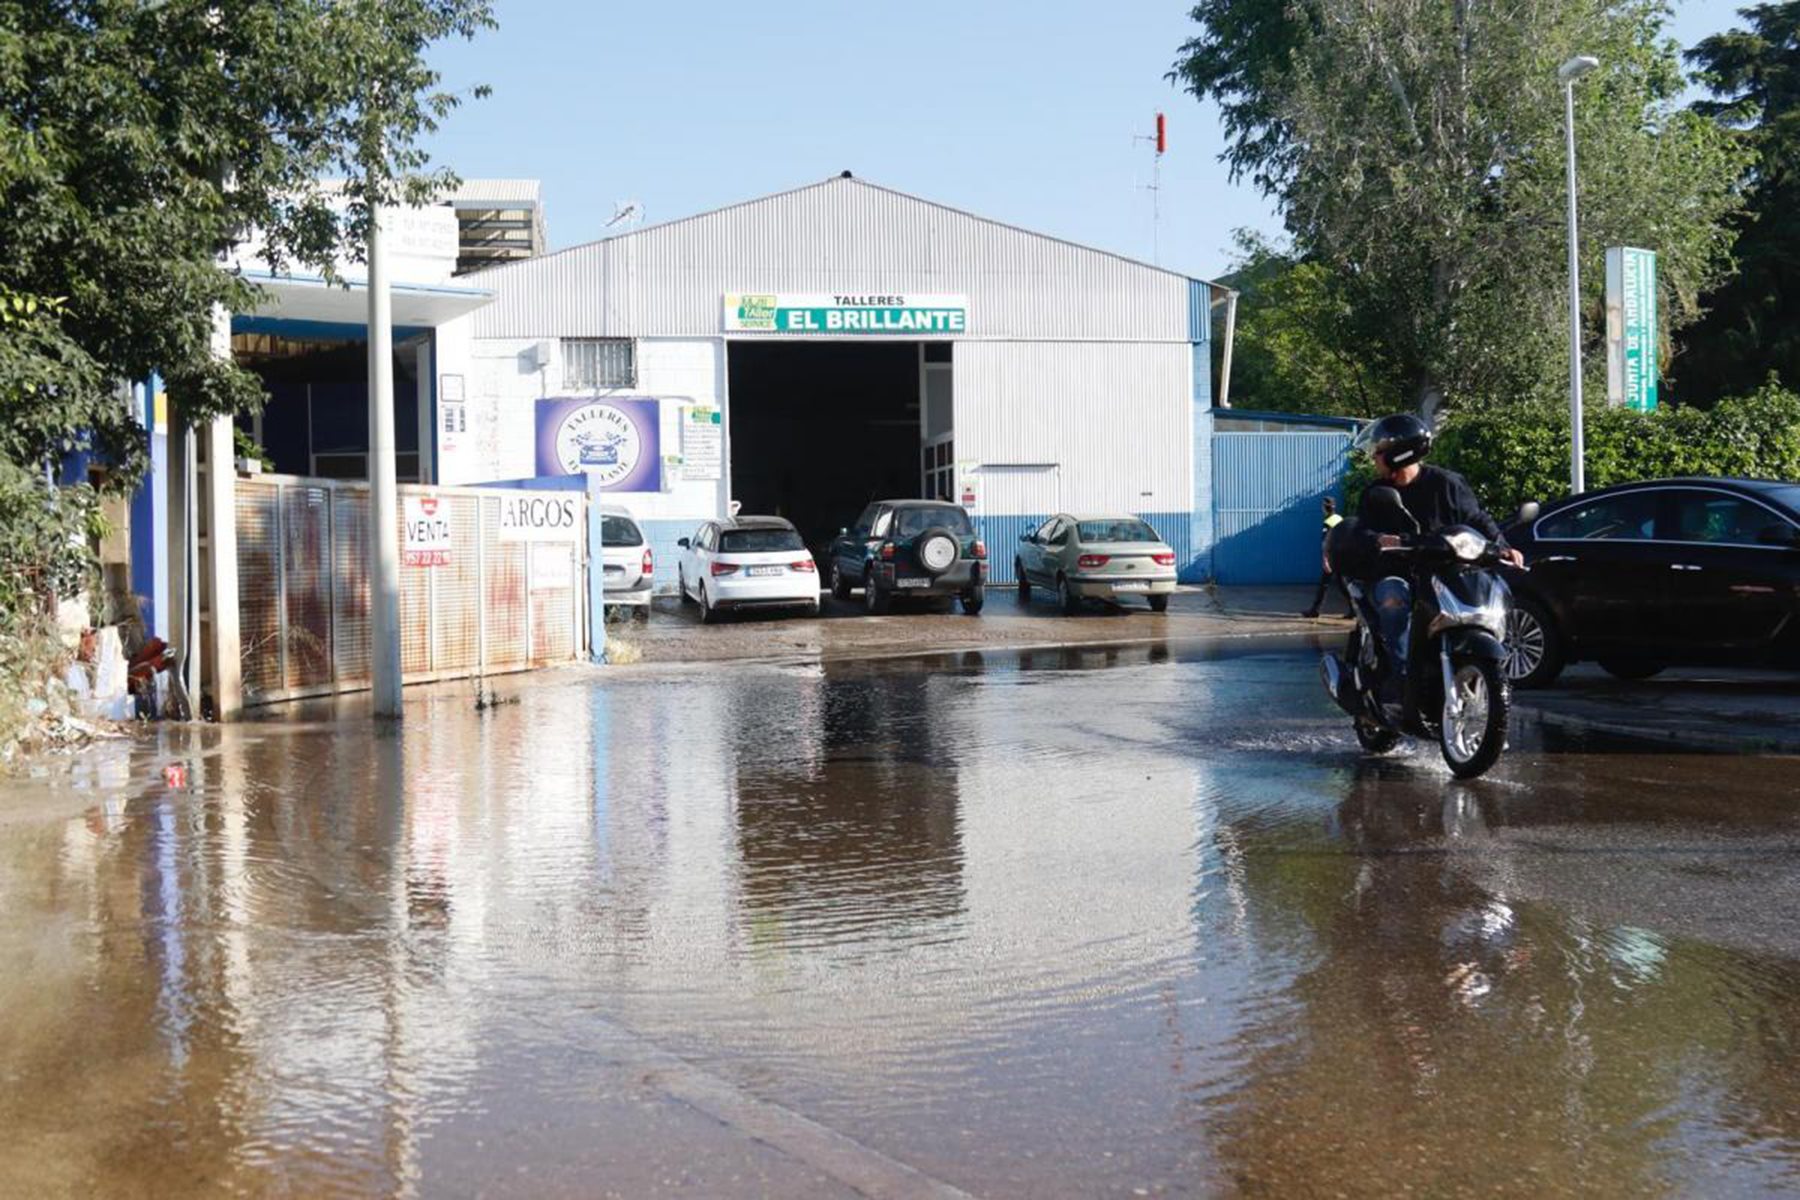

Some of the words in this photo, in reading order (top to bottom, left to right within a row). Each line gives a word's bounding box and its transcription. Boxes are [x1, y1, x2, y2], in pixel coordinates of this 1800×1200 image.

[834, 295, 905, 306] TALLERES
[788, 310, 819, 329] EL
[827, 310, 964, 330] BRILLANTE
[1628, 335, 1639, 350] DE
[1627, 358, 1639, 401] JUNTA
[567, 409, 628, 432] TALLERES
[503, 498, 574, 528] ARGOS
[407, 520, 449, 542] VENTA
